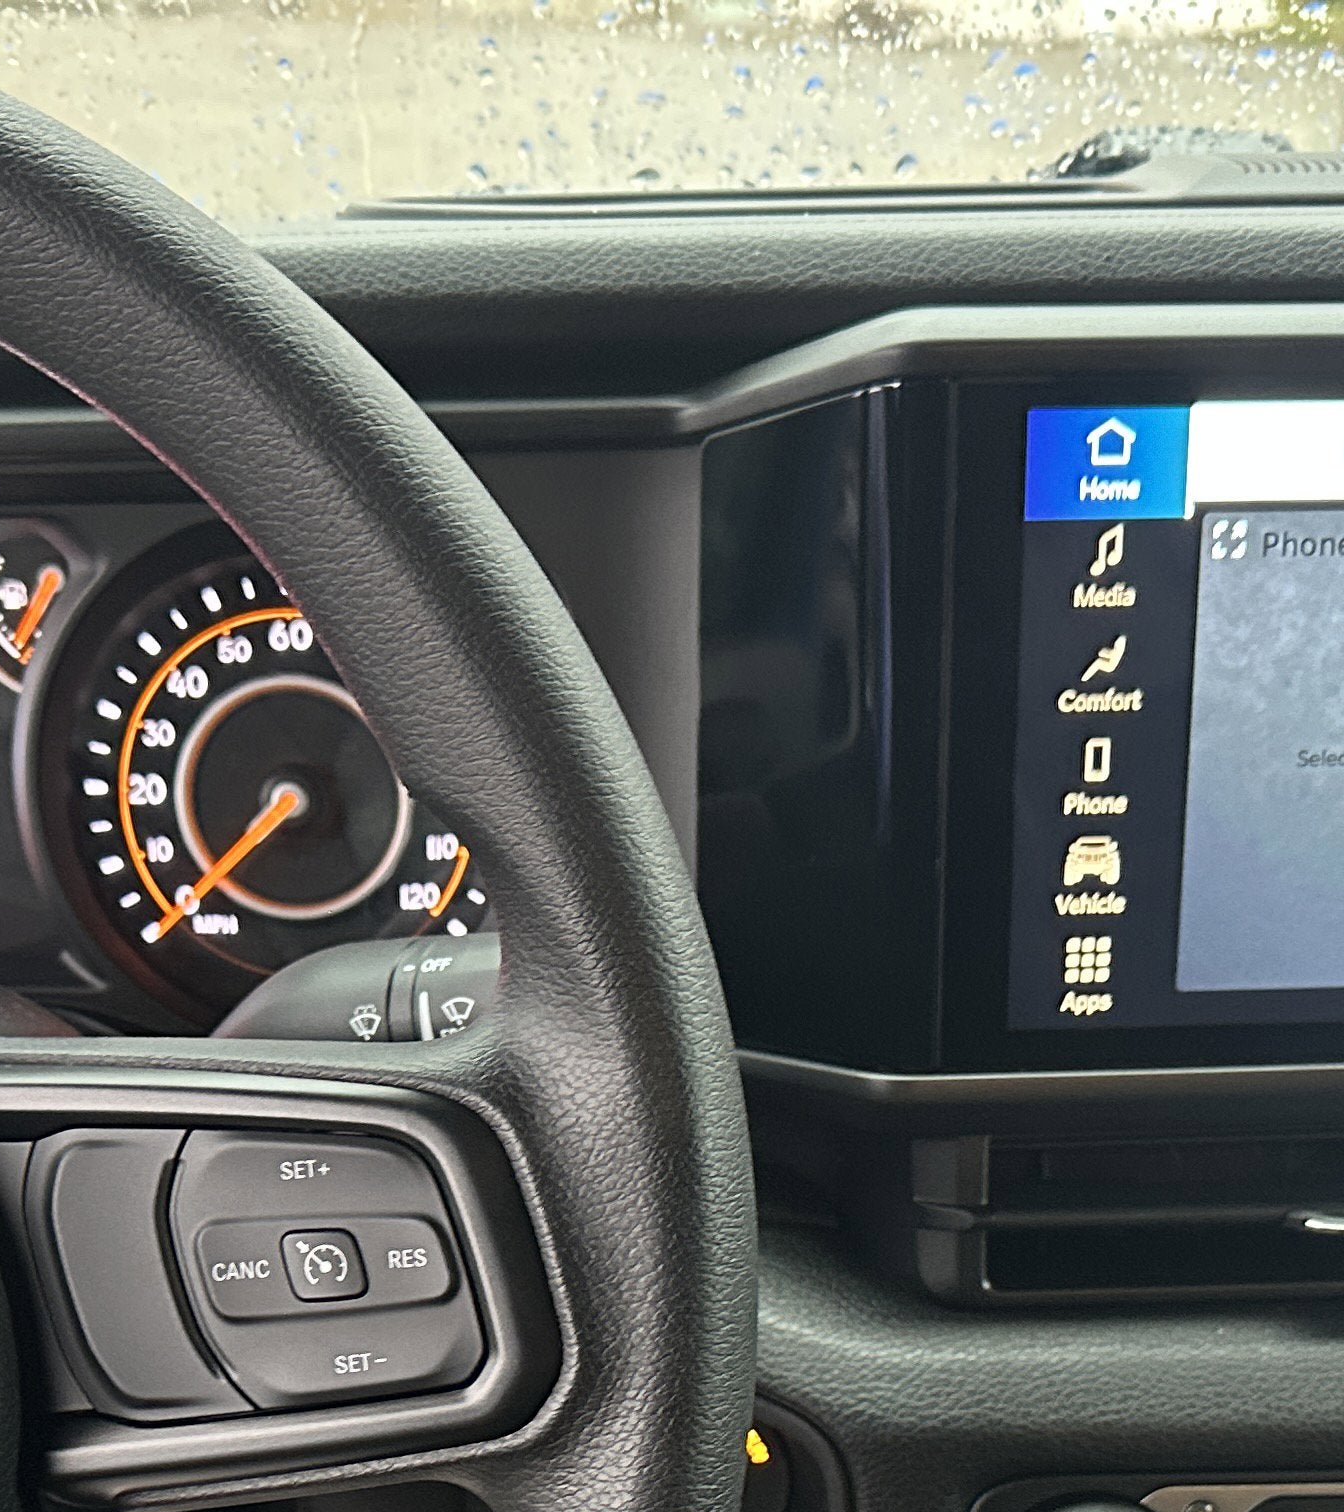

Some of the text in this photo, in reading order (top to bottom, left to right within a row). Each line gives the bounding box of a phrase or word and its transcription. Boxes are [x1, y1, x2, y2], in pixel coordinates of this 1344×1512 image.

[1078, 475, 1142, 502] Home
[1072, 582, 1138, 609] Media
[267, 618, 315, 652] 60
[216, 634, 254, 665] 50
[165, 664, 210, 700] 40
[1056, 686, 1144, 713] Comfort
[140, 718, 177, 749] 30
[127, 773, 169, 807] 20
[1061, 791, 1130, 817] Phone
[145, 834, 175, 865] 10
[425, 832, 461, 862] 110
[173, 883, 202, 916] 0
[399, 881, 442, 912] 120
[1054, 890, 1128, 917] Vehicle
[191, 912, 240, 937] MPH
[419, 957, 454, 973] OFF
[1059, 990, 1114, 1017] Apps
[278, 1158, 332, 1182] SET+
[210, 1258, 272, 1284] CANC
[387, 1247, 429, 1271] RES
